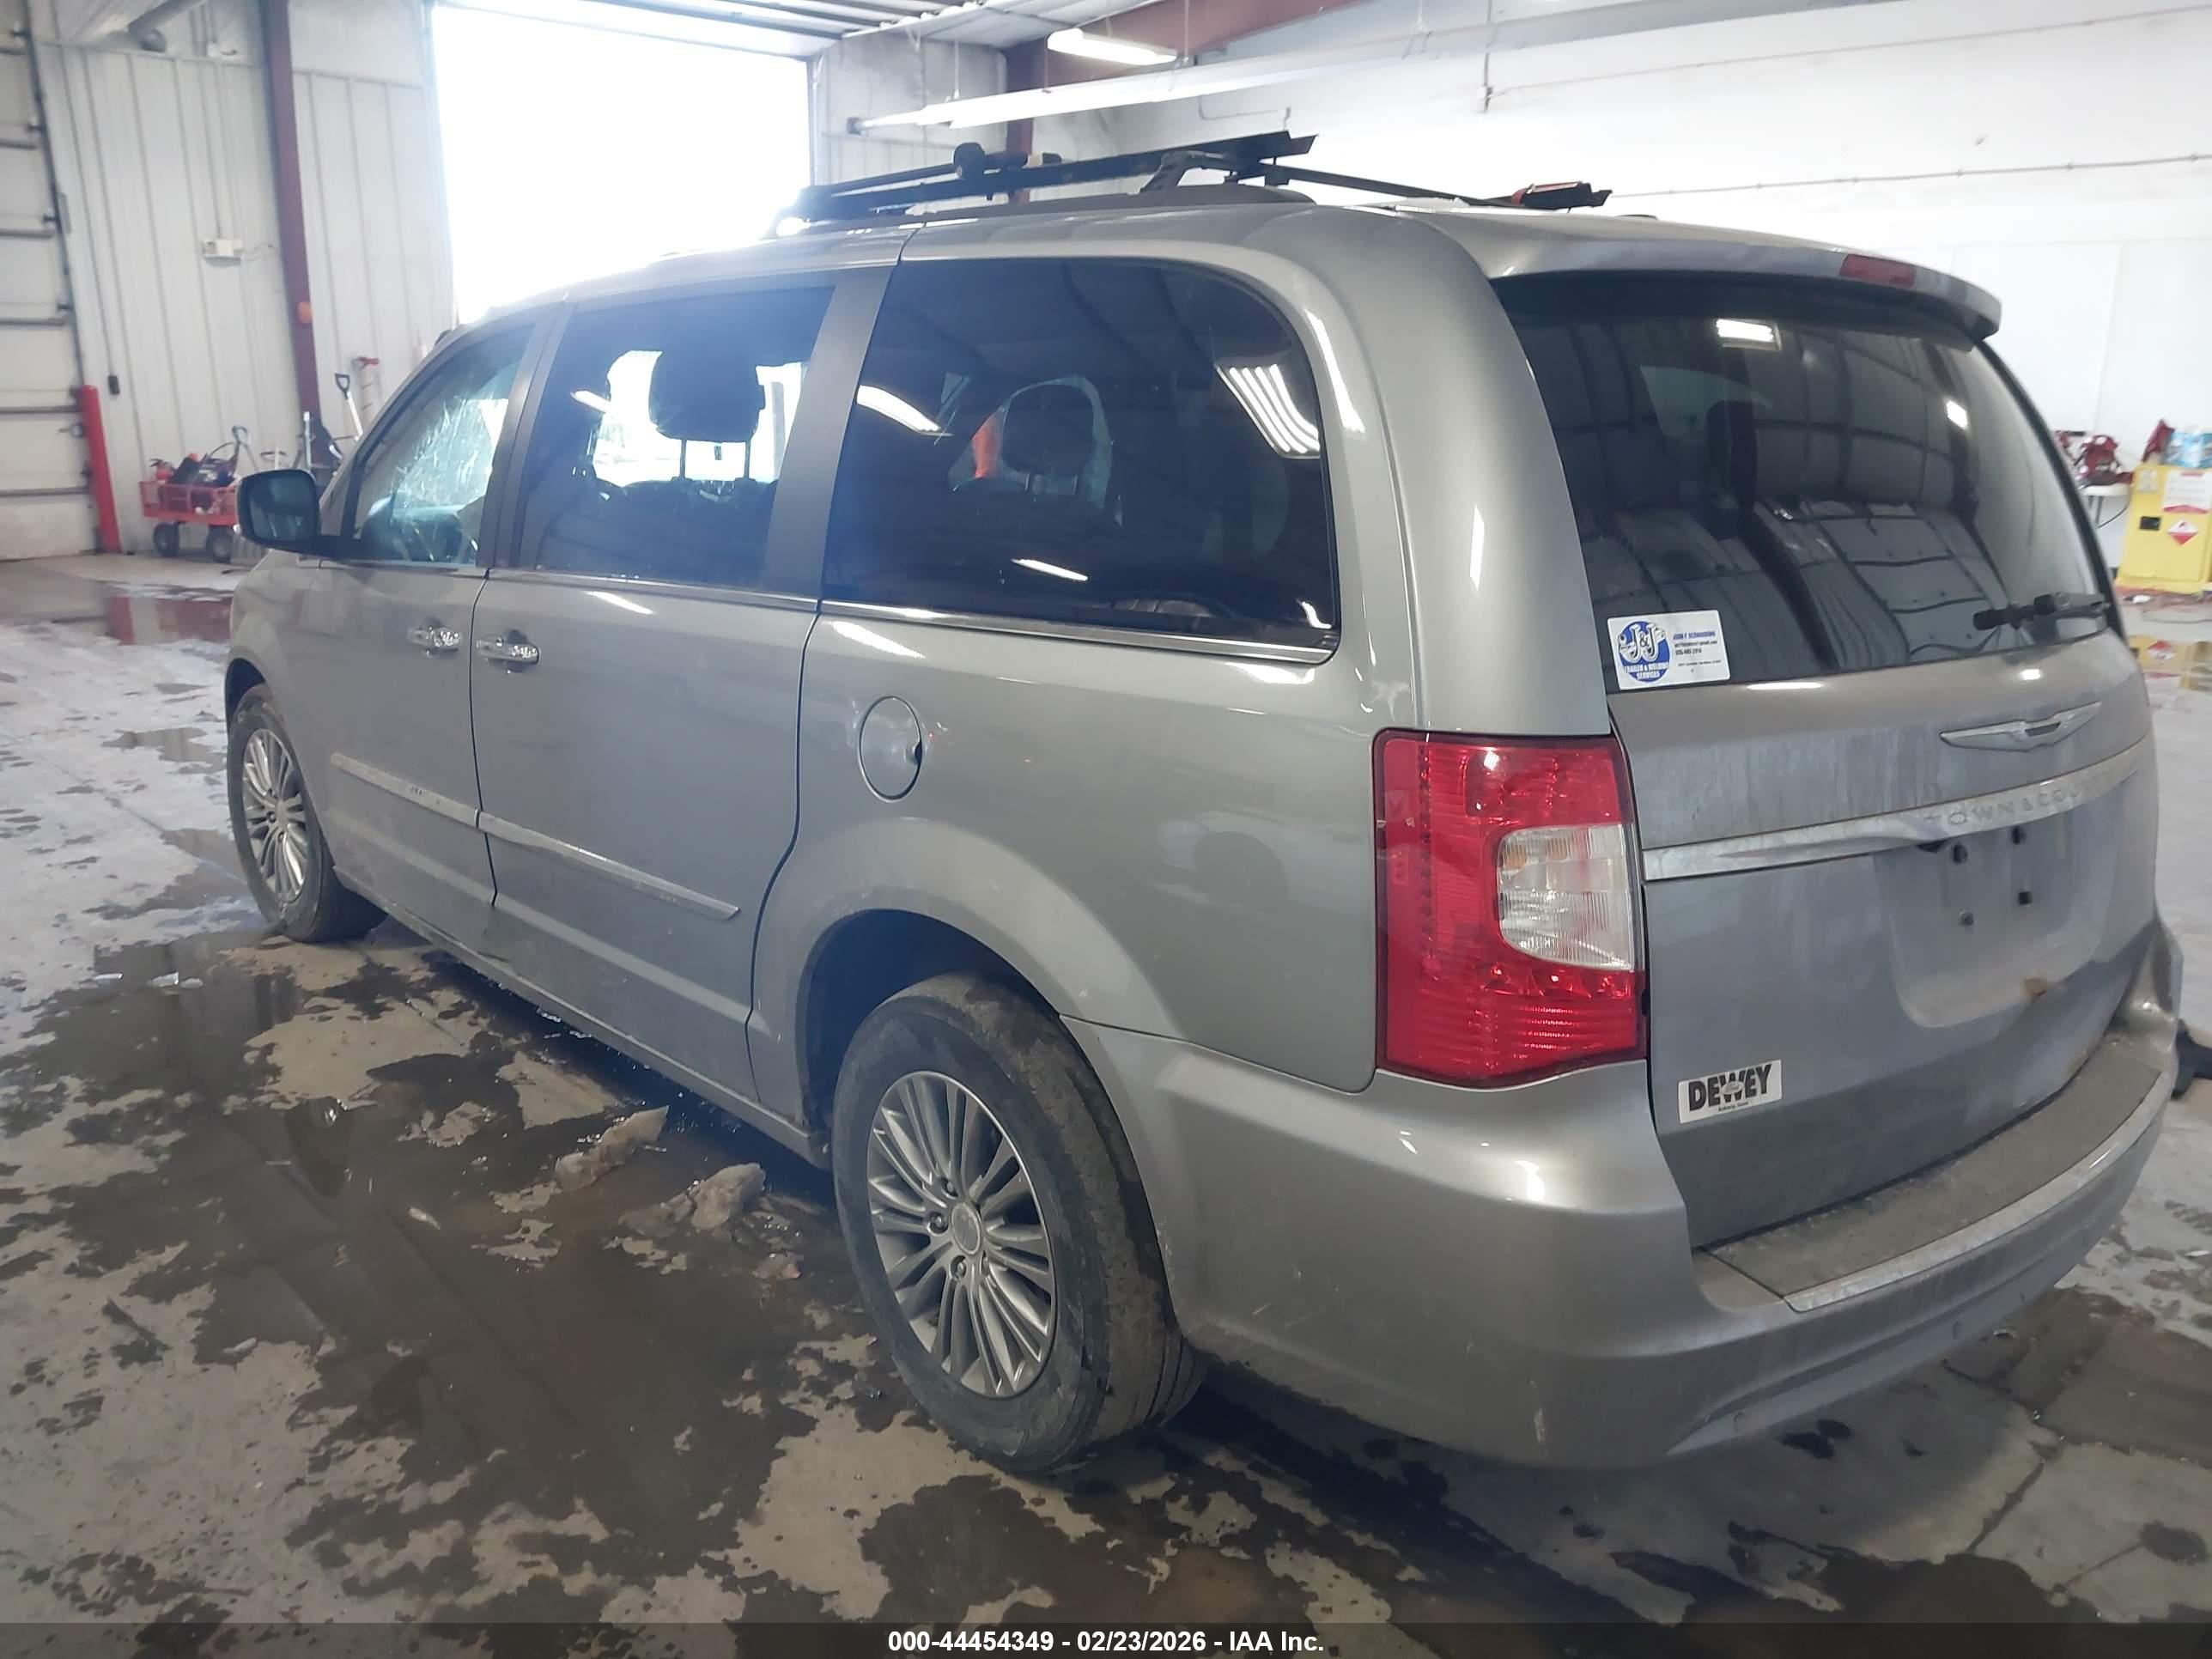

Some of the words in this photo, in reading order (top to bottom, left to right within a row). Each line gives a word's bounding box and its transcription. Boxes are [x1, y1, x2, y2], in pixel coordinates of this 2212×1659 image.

[1628, 623, 1658, 662] J&J
[1636, 671, 1660, 680] SERVICES
[1688, 1063, 1772, 1111] DEWEY
